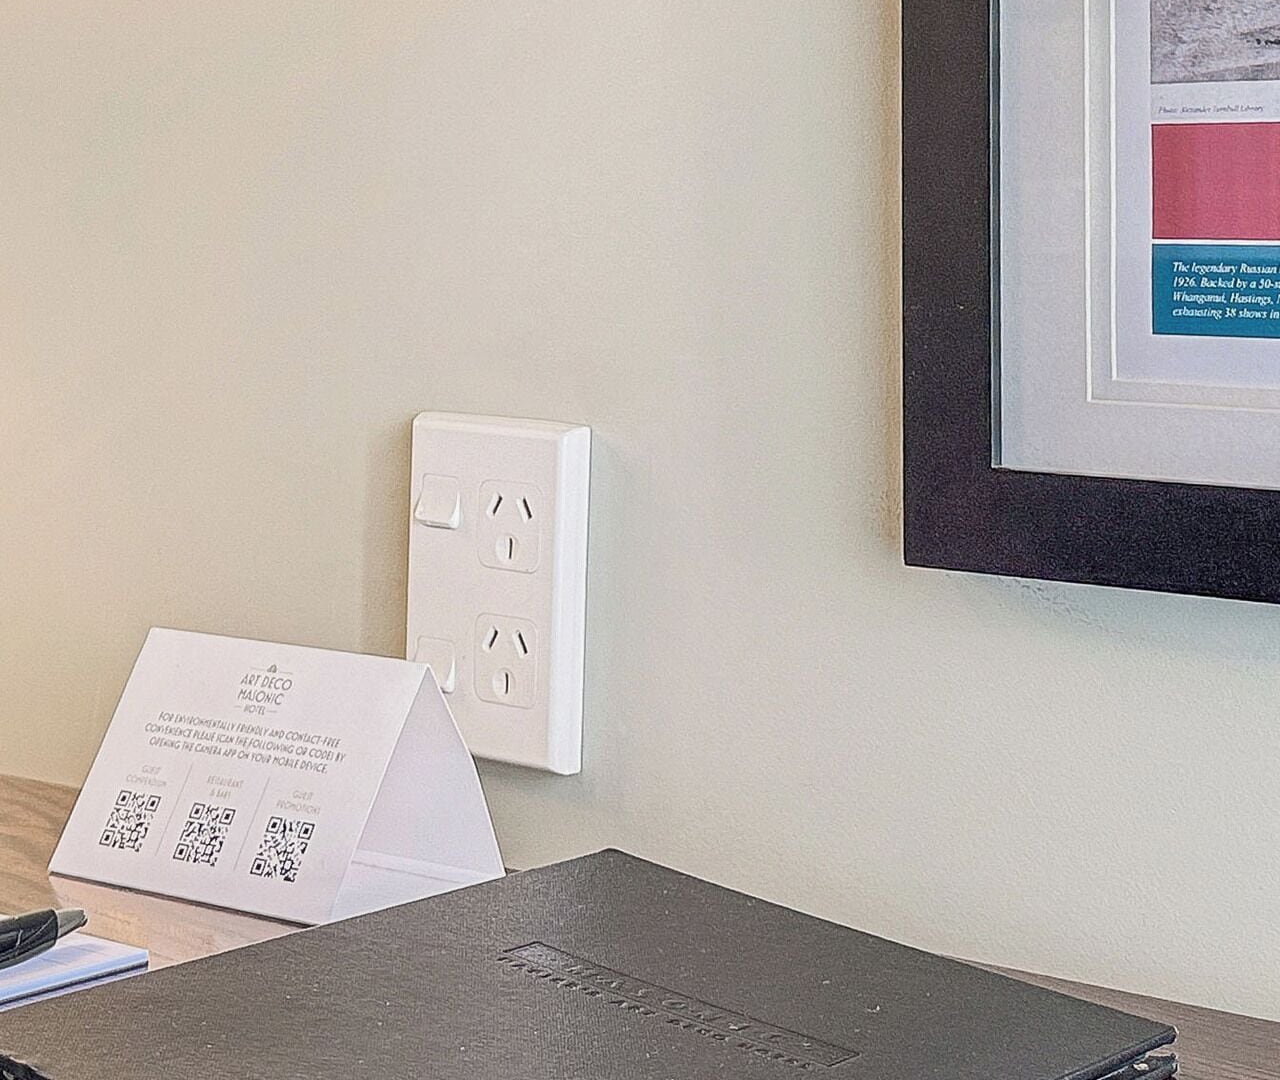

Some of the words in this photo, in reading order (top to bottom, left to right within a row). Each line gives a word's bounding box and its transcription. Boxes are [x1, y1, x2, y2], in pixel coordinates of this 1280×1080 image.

[1173, 261, 1190, 272] The
[1239, 263, 1277, 273] Russian
[1200, 277, 1235, 288] Backed
[1235, 278, 1247, 290] by
[1238, 308, 1267, 318] shows
[1269, 309, 1280, 319] in
[241, 674, 261, 686] ART
[261, 676, 293, 690] DECO
[237, 688, 284, 705] MASONIC
[236, 724, 268, 736] FRIENDLY
[269, 729, 285, 738] AND
[285, 731, 340, 747] CONTACT-FREE
[194, 744, 222, 755] CAMERA
[223, 749, 237, 758] APP
[248, 739, 295, 753] FOLLOWING
